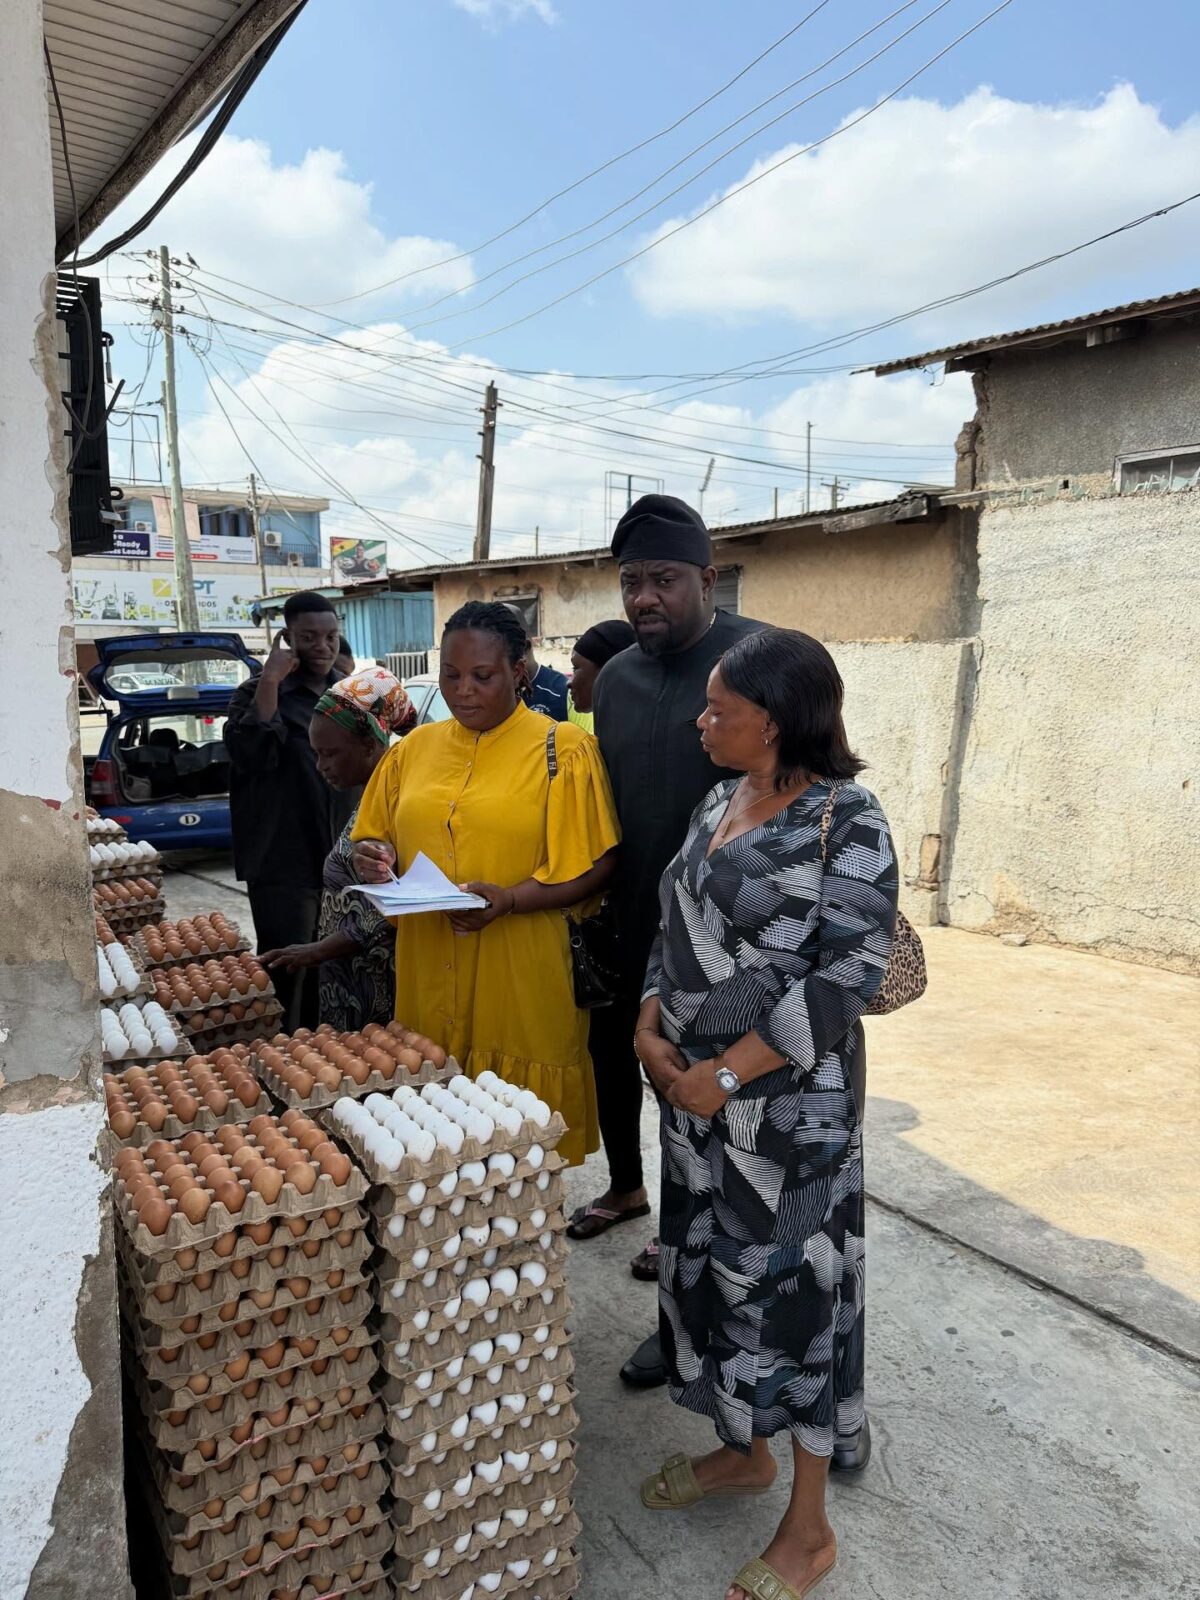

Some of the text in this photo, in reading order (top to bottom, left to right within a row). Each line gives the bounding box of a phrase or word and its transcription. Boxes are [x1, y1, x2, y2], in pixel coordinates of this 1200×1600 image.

[113, 540, 140, 549] -Ready
[193, 580, 216, 594] PT
[184, 815, 197, 825] D
